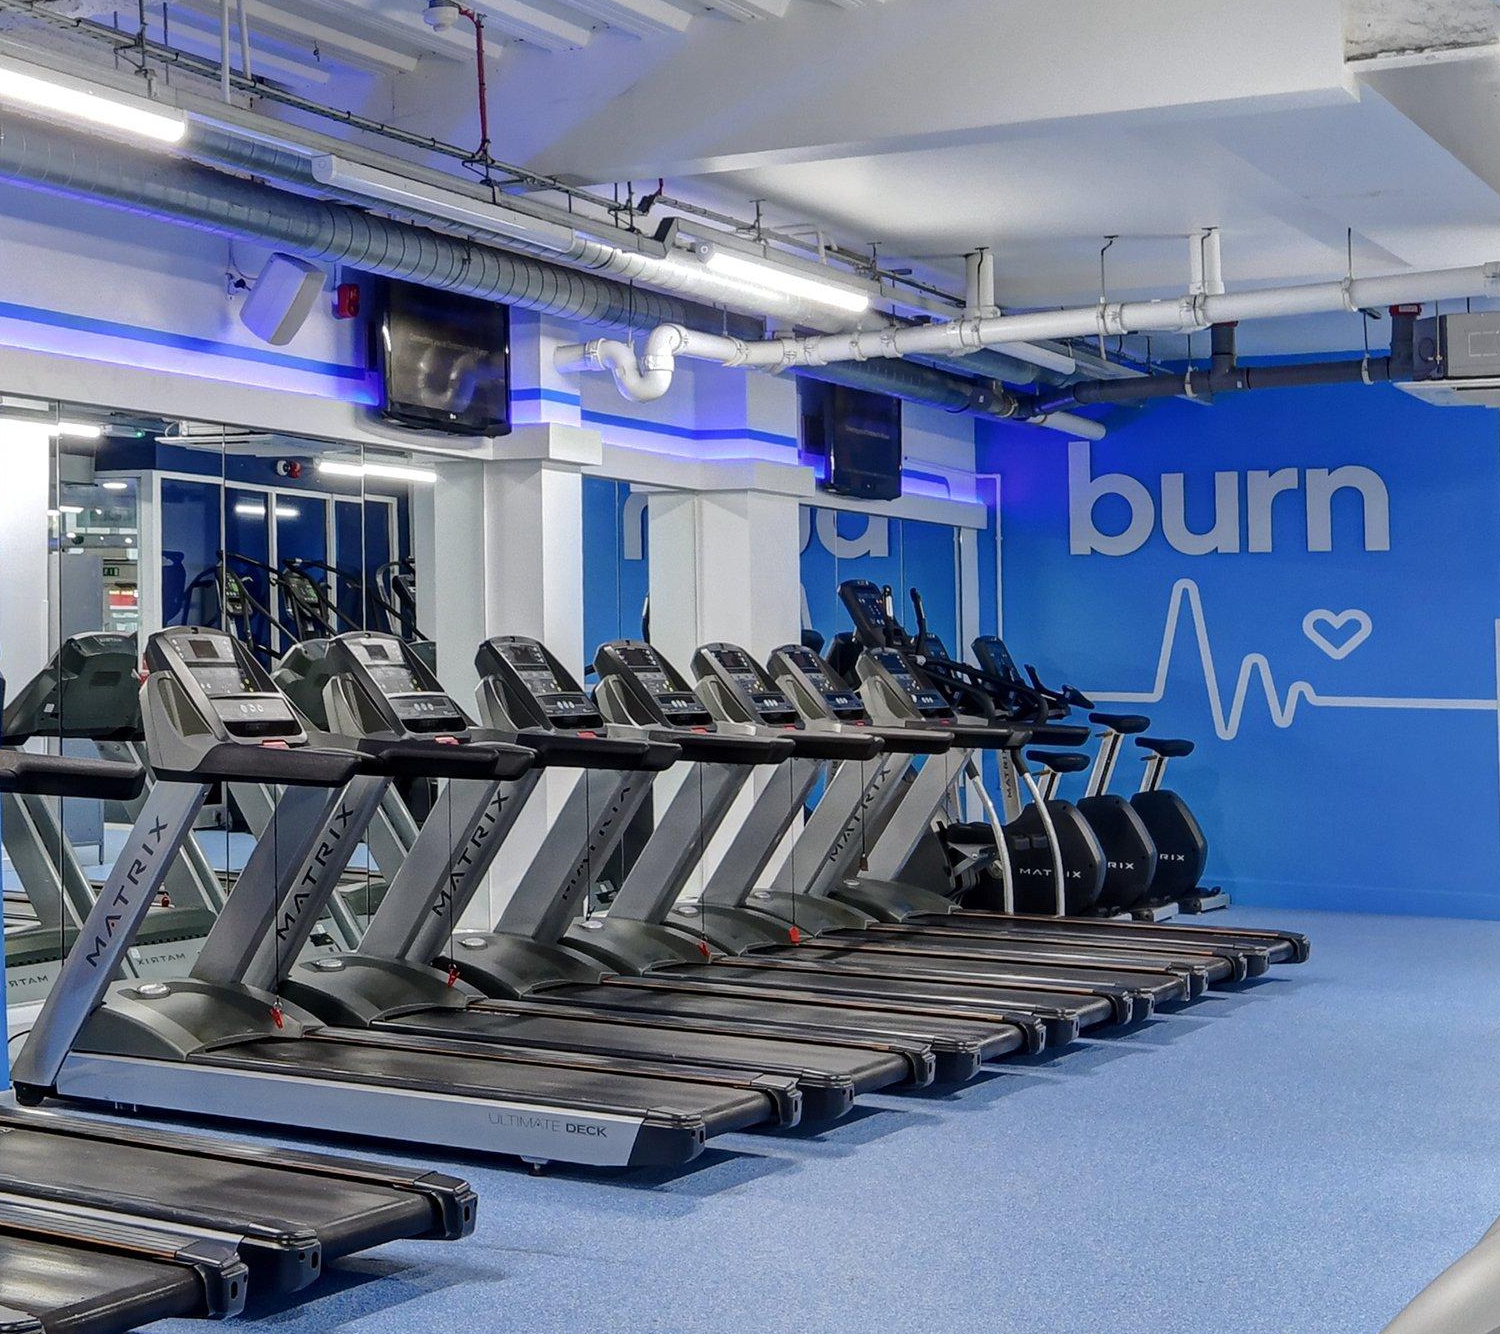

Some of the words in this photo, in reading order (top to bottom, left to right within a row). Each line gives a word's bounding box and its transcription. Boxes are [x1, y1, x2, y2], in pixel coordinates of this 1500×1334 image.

[1068, 441, 1391, 557] burn
[276, 802, 354, 941] MATRIX
[432, 789, 510, 918] MATRIX
[829, 767, 891, 863] MATRIX
[1019, 867, 1082, 879] MATIX
[86, 815, 169, 968] MATRIX
[488, 1111, 561, 1135] ULTIMATE
[565, 1121, 608, 1140] DECK
